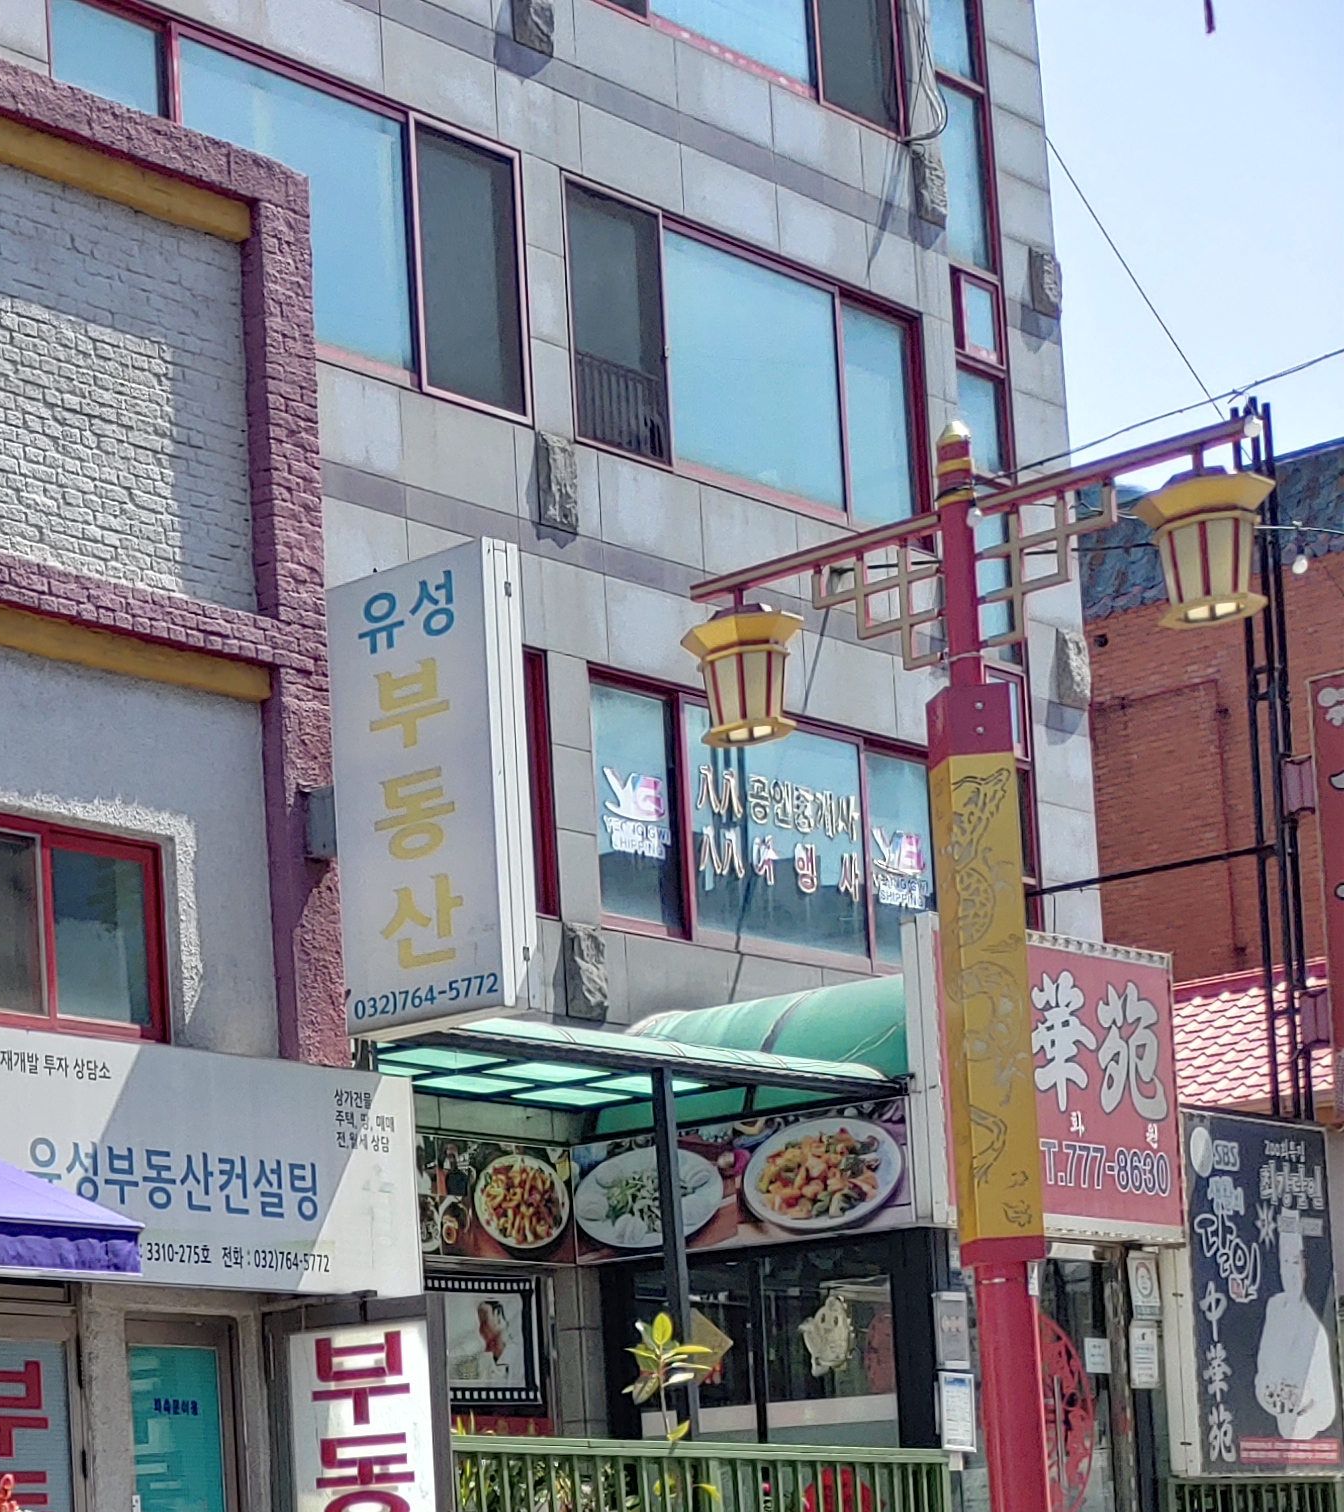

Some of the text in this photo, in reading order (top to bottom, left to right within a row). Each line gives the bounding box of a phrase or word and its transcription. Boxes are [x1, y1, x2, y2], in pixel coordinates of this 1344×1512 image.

[357, 570, 456, 654] 유성
[368, 657, 464, 971] 부동산
[749, 774, 859, 843] 공인중개사
[353, 971, 499, 1021] 032)764-5772
[0, 1049, 40, 1074] 재개발
[44, 1054, 70, 1078] 투자
[73, 1058, 112, 1081] 상담소
[334, 1089, 372, 1110] 상가건물
[371, 1134, 390, 1153] 상담
[1215, 1144, 1238, 1168] SBS
[1040, 1141, 1171, 1197] T.777-8630
[146, 1243, 330, 1273] 3310-275호 전화 032)764-5772
